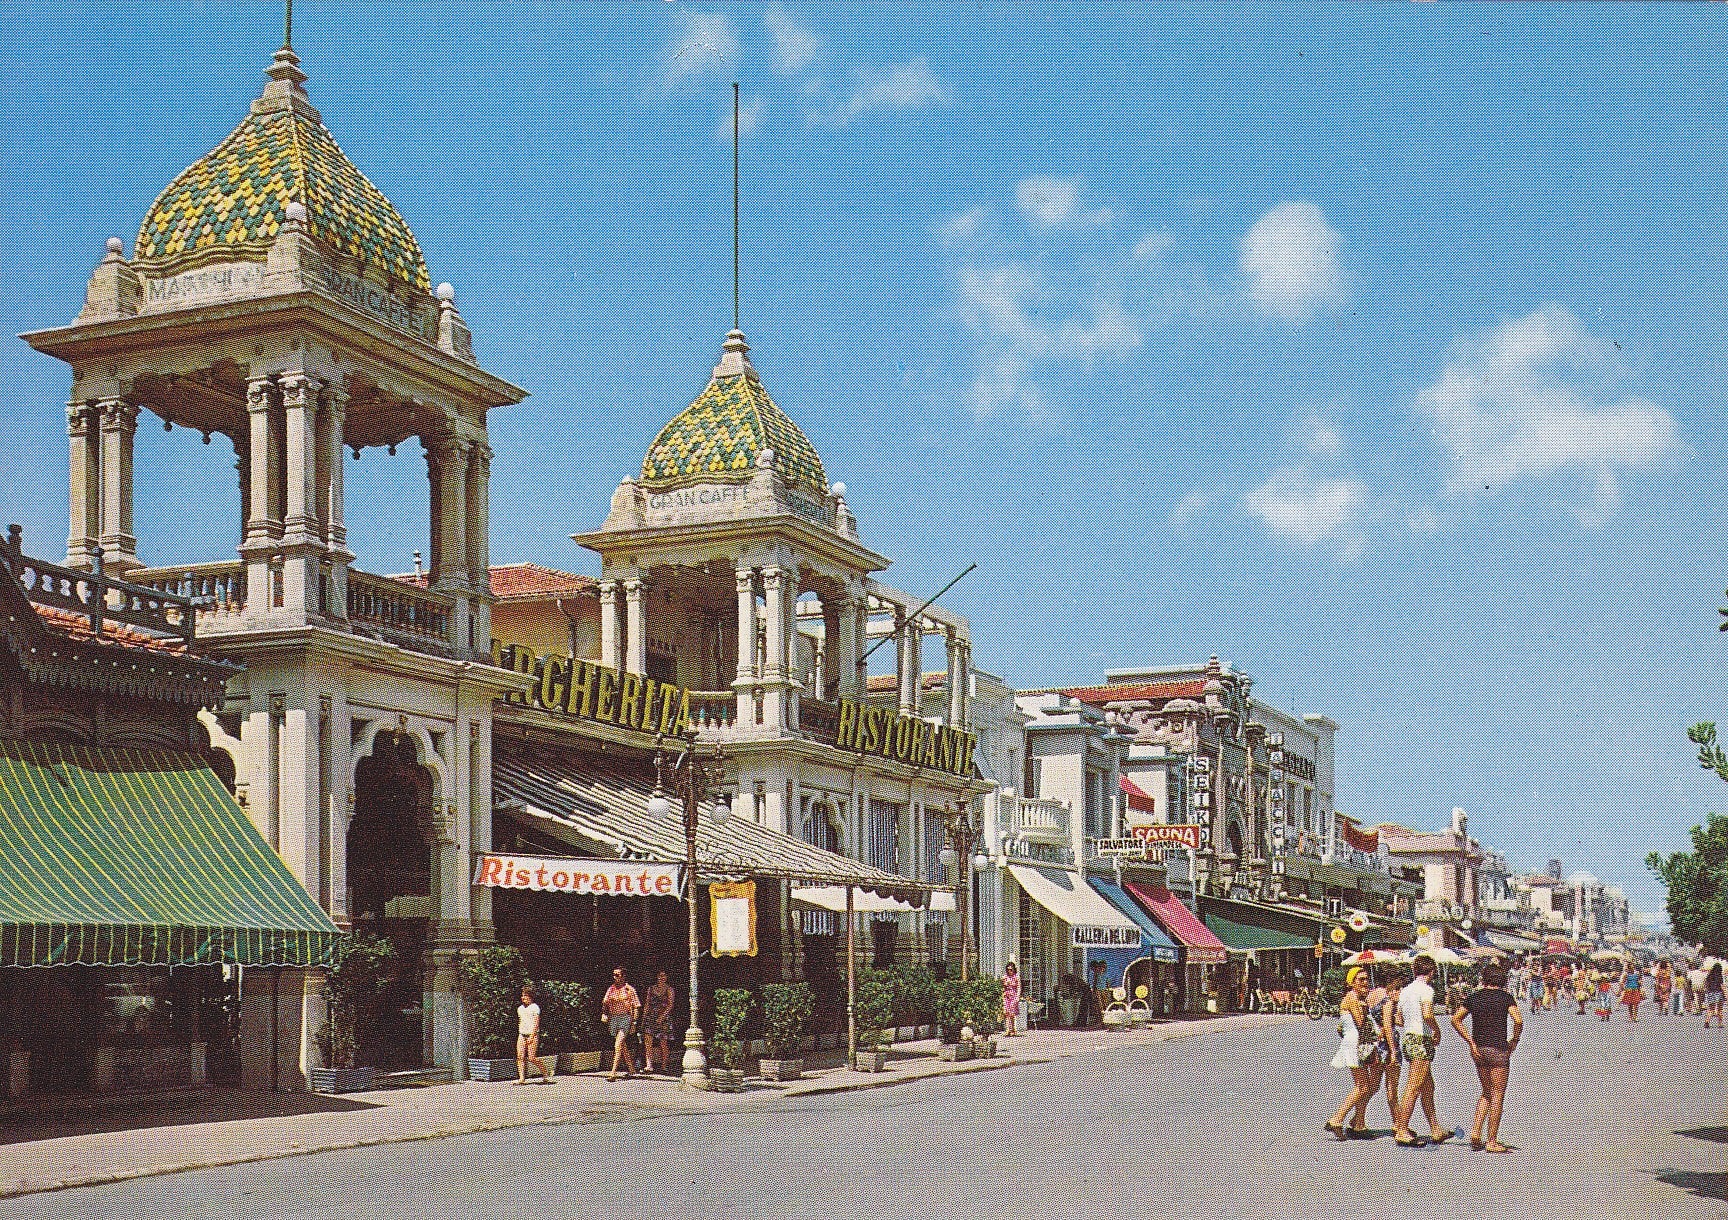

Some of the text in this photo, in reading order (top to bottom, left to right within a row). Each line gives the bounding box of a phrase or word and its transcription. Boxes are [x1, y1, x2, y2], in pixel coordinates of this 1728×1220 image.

[649, 490, 696, 510] GRAN
[836, 698, 978, 777] RISTORANTE
[1194, 756, 1209, 841] SEIKO
[1270, 732, 1284, 874] TABACCHI
[1099, 839, 1144, 850] SALVATORE
[1135, 827, 1197, 849] SAUNA
[479, 856, 673, 895] Ristorante
[1075, 927, 1108, 944] GALLERIA
